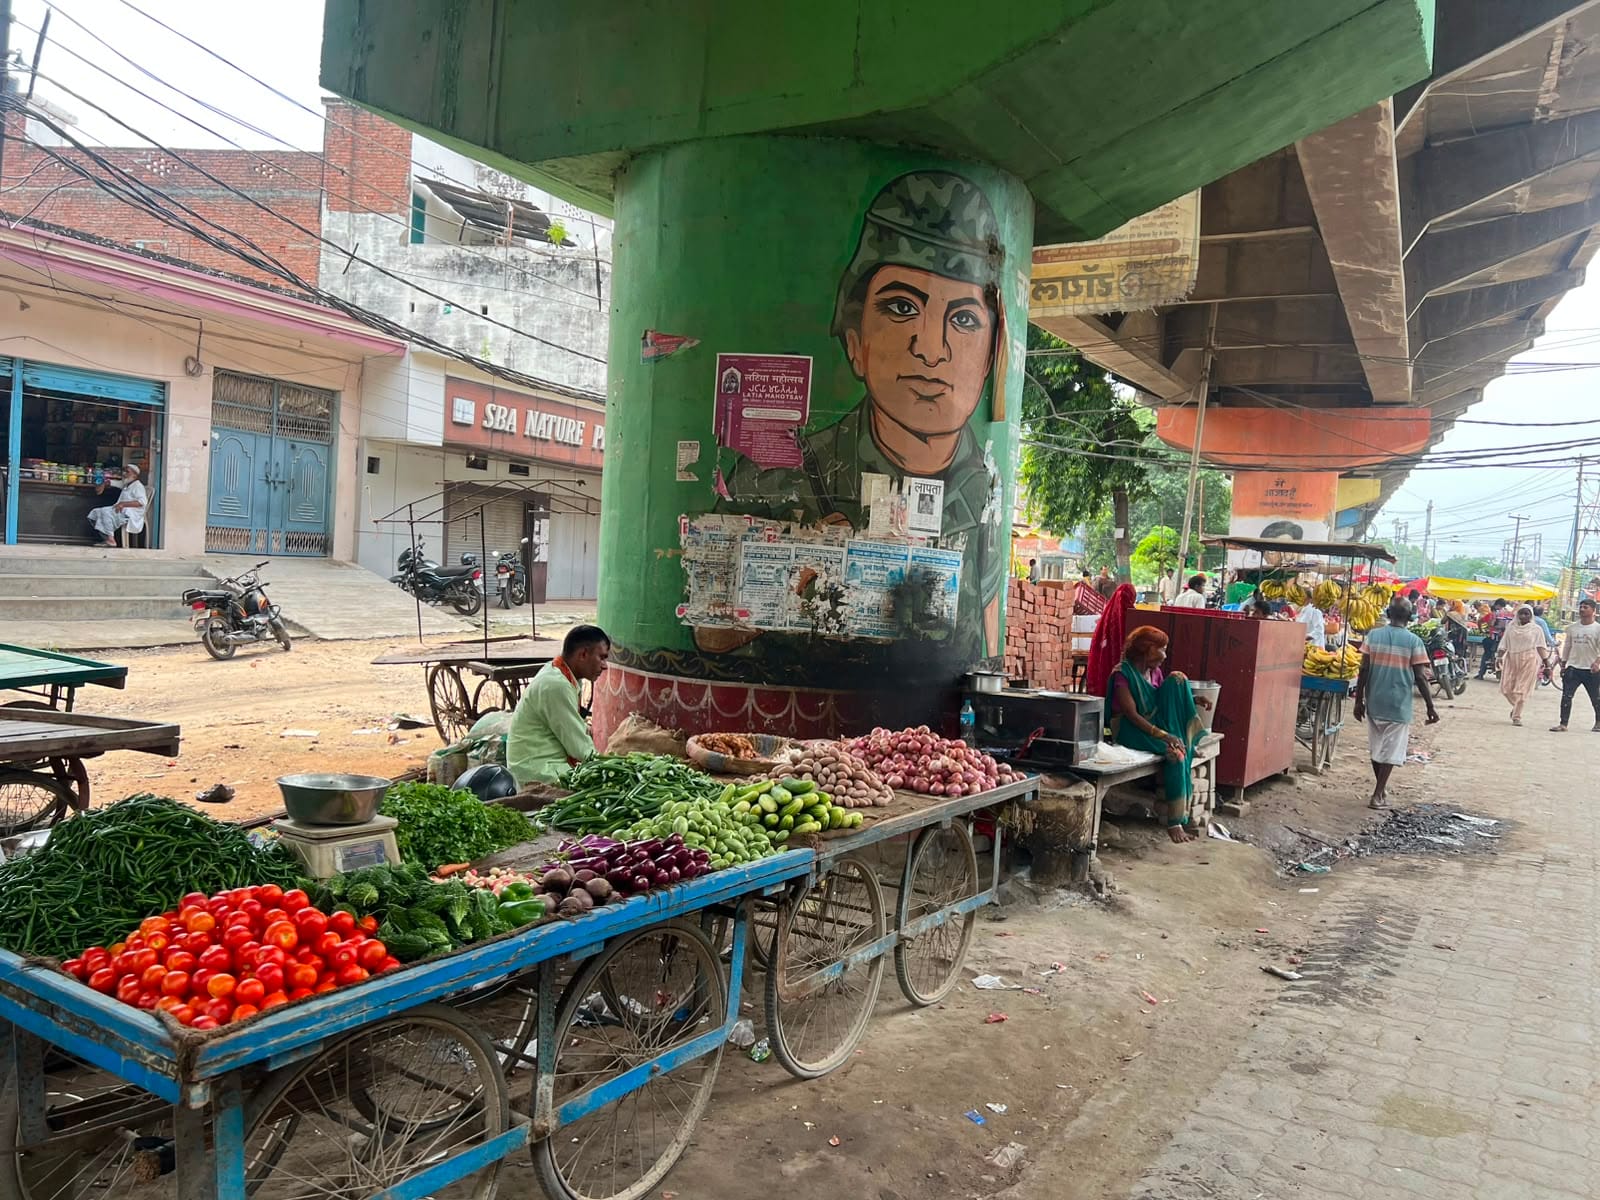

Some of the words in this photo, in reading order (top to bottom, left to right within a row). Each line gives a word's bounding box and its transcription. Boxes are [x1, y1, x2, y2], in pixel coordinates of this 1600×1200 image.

[771, 373, 804, 385] महोत्सव
[764, 393, 804, 401] MAHOTSAV
[482, 403, 518, 434] SBA
[523, 409, 586, 446] NATURE
[914, 482, 942, 495] लापता
